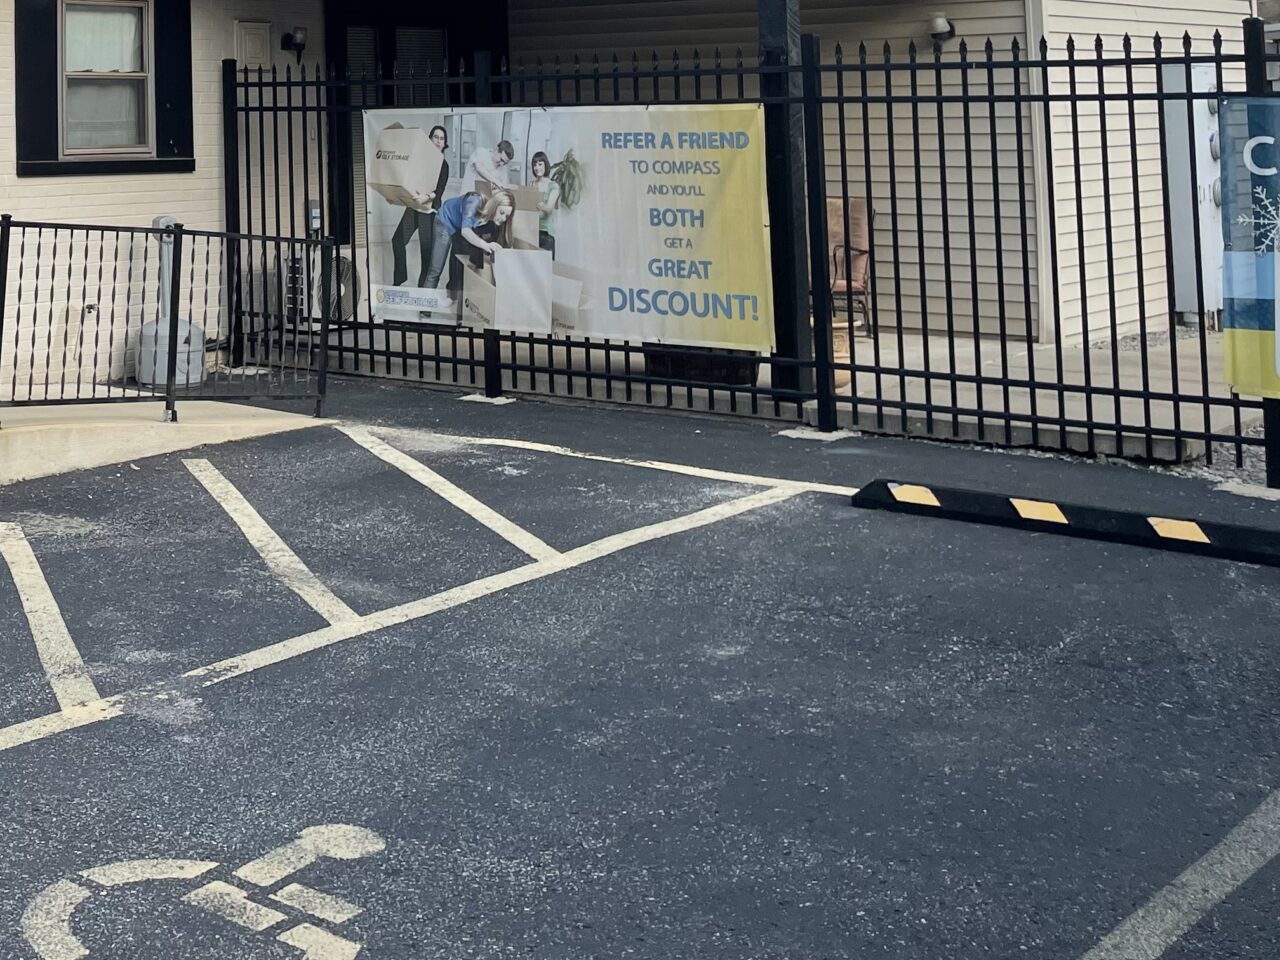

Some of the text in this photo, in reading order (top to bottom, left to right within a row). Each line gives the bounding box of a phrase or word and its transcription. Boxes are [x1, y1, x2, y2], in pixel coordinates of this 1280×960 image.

[601, 131, 750, 149] REFER A FRIEND
[1243, 135, 1278, 176] C
[629, 160, 721, 176] TO COMPASS
[646, 184, 705, 196] AND YOU'LL
[649, 207, 705, 228] BOTH
[664, 237, 693, 249] GET A
[647, 257, 713, 280] GREAT
[608, 286, 759, 321] DISCOUNT!
